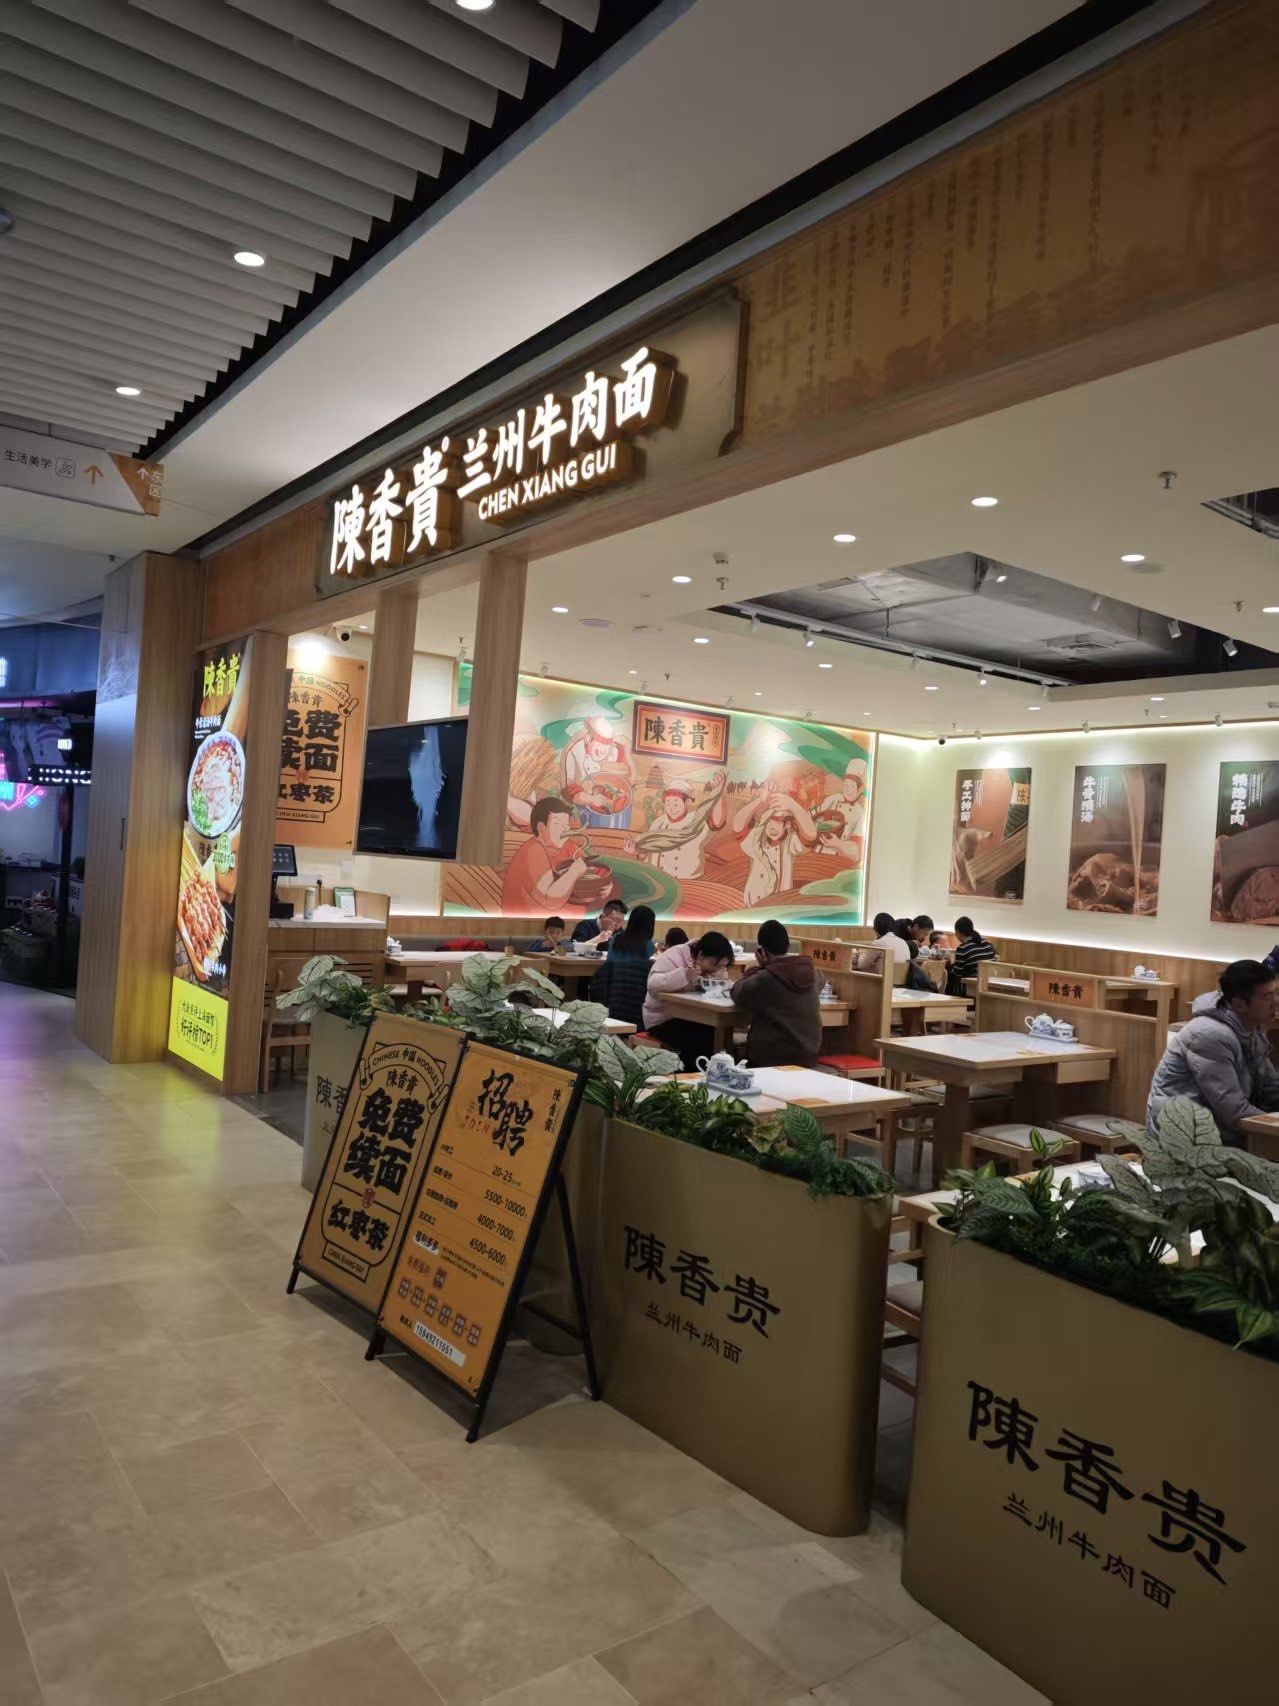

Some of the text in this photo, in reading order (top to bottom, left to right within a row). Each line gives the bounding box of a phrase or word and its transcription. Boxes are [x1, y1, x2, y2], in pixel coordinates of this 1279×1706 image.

[4, 449, 53, 469] 生活美学
[330, 445, 449, 575] 陳香貴
[457, 346, 658, 499] 兰州牛肉面
[478, 444, 617, 520] CHEN XIANG GUI
[203, 653, 240, 698] 陳香貴
[644, 716, 708, 752] 陳香貴
[280, 782, 335, 804] 枣茶
[372, 1049, 400, 1066] CHINESE
[416, 1055, 440, 1086] NOODLES
[358, 1087, 425, 1149] 免费
[478, 1068, 533, 1157] 招聘
[343, 1131, 412, 1196] 续面
[492, 1165, 514, 1182] 20-25
[328, 1198, 390, 1251] 红枣茶
[477, 1213, 515, 1241] 4000-7000
[484, 1189, 526, 1217] 5500-10000
[469, 1237, 507, 1266] 4500-6000
[623, 1224, 781, 1339] 陳香贵
[645, 1301, 743, 1365] 兰州牛肉面
[967, 1379, 1247, 1585] 陳香贵
[1002, 1492, 1176, 1609] 兰州牛肉面
